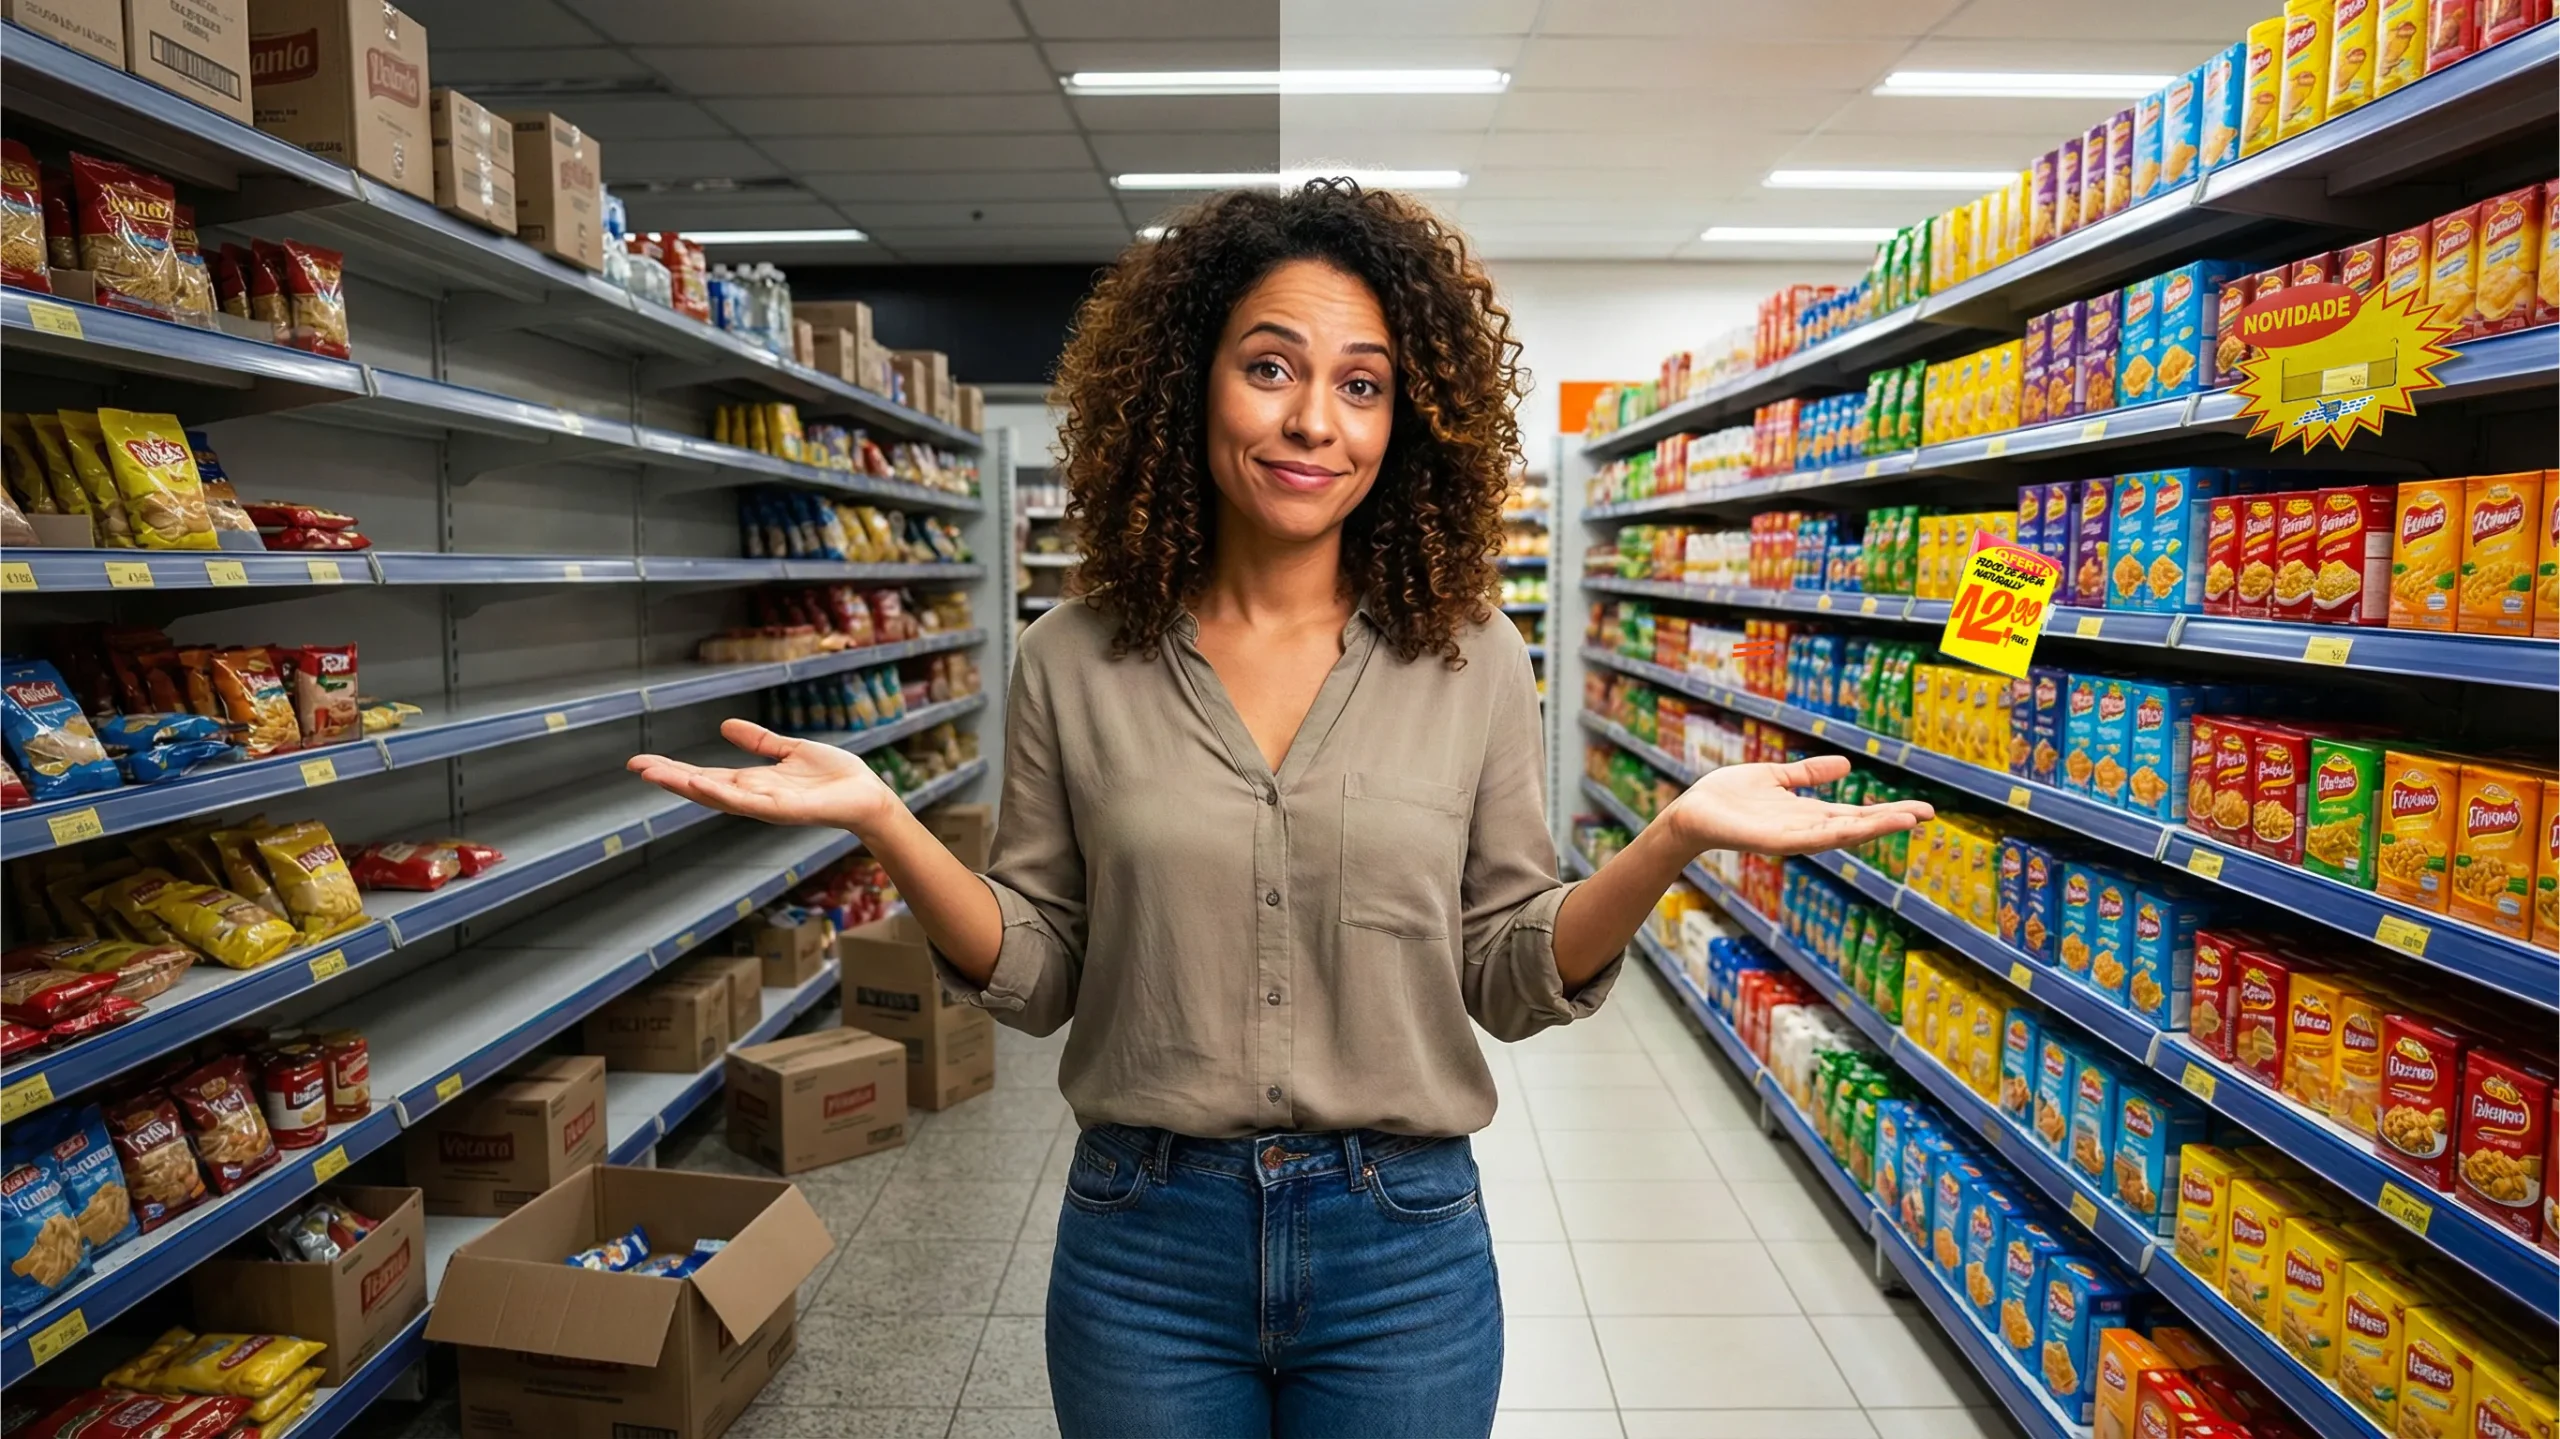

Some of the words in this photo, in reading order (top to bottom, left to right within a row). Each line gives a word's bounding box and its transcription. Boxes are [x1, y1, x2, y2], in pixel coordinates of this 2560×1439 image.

[2243, 295, 2351, 336] NOVIDADE
[1997, 549, 2051, 577] OFERTA
[1973, 568, 2025, 590] NATURALLY
[2004, 568, 2018, 577] DE
[2016, 571, 2046, 587] AVEIA
